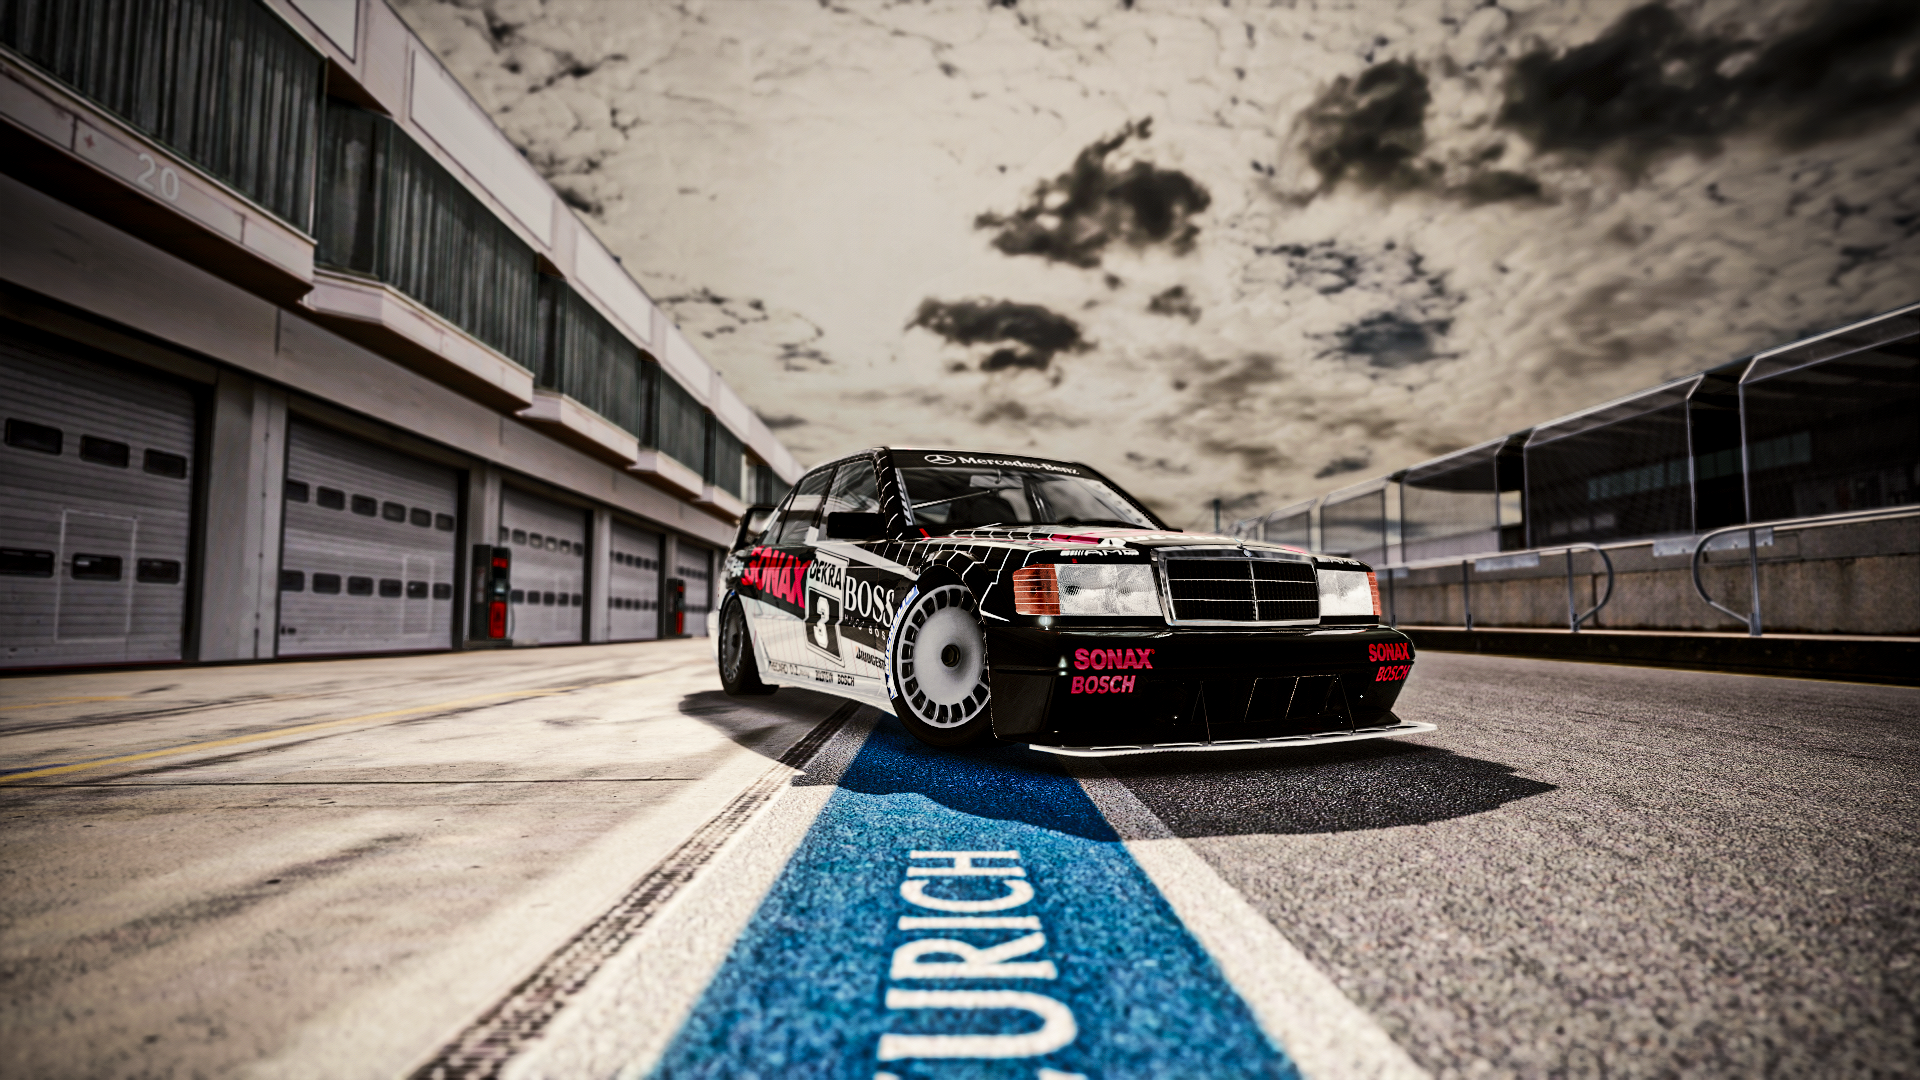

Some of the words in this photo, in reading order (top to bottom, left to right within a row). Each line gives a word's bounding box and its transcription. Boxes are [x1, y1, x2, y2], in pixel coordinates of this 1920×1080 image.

[137, 153, 179, 201] 20
[957, 456, 1080, 475] Mercedes-Benz
[741, 545, 812, 609] SONAX
[809, 560, 842, 590] DEKRA
[844, 576, 895, 628] BOSS
[813, 596, 830, 649] 3
[1074, 647, 1154, 671] SONAX
[1368, 643, 1410, 662] SONAX
[1071, 675, 1136, 694] BOSCH
[1375, 664, 1411, 682] BOSCH
[872, 850, 1089, 1080] URICH
